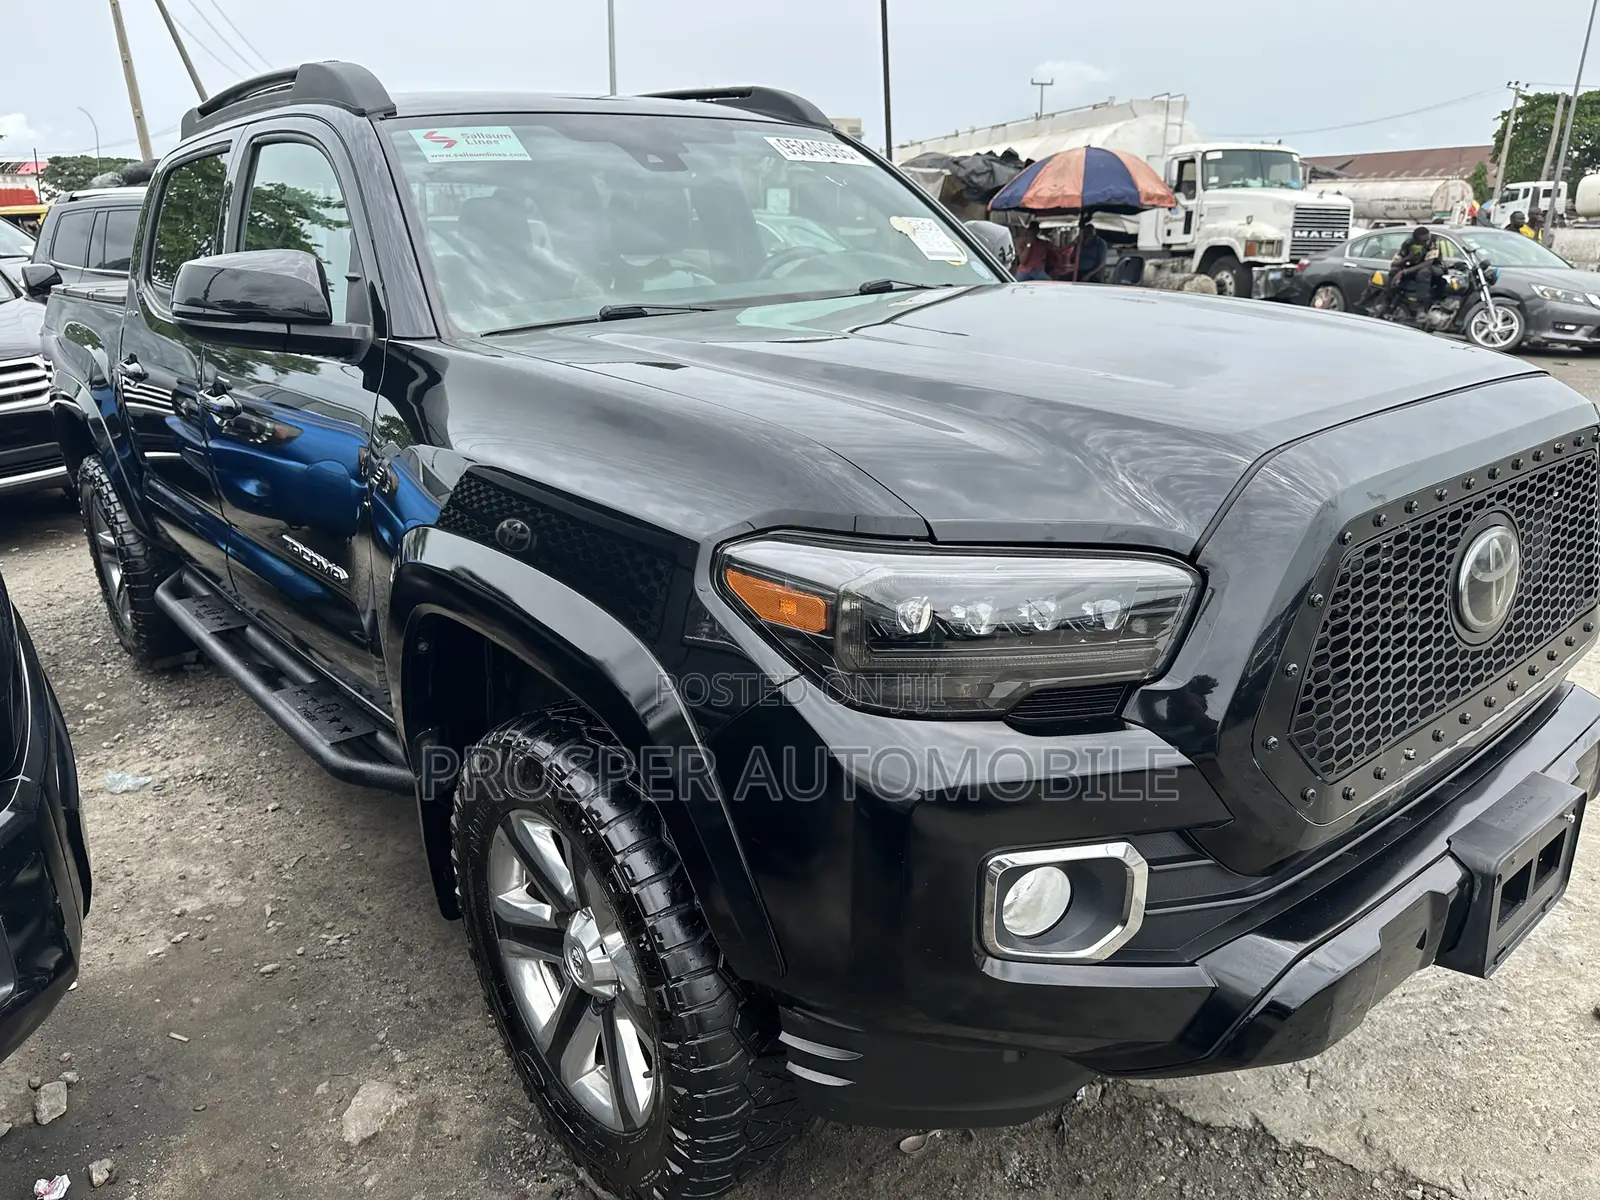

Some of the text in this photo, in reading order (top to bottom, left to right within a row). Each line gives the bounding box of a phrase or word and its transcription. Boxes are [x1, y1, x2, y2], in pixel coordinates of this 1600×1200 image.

[460, 132, 512, 140] Sallaum
[465, 138, 500, 146] Lines
[430, 151, 528, 159] www.sallaumlines.com
[1294, 230, 1347, 239] MACK
